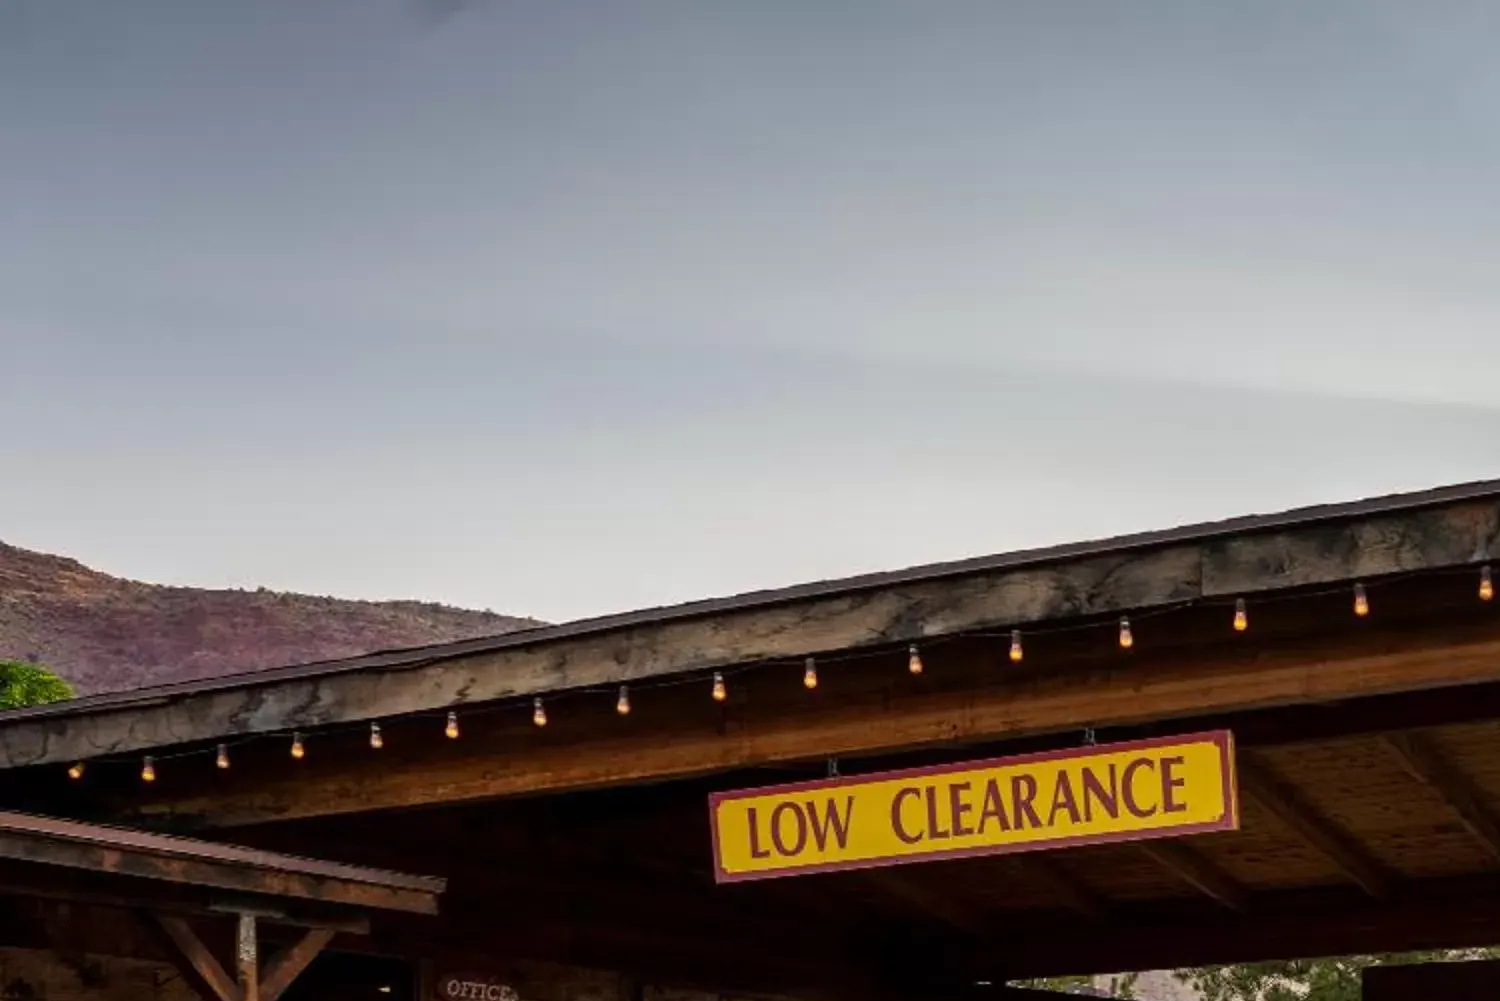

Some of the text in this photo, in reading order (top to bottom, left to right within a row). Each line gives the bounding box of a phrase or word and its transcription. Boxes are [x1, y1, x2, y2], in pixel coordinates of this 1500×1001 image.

[747, 755, 1188, 859] LOW CLEARANCE
[447, 979, 513, 1001] OFFICE
